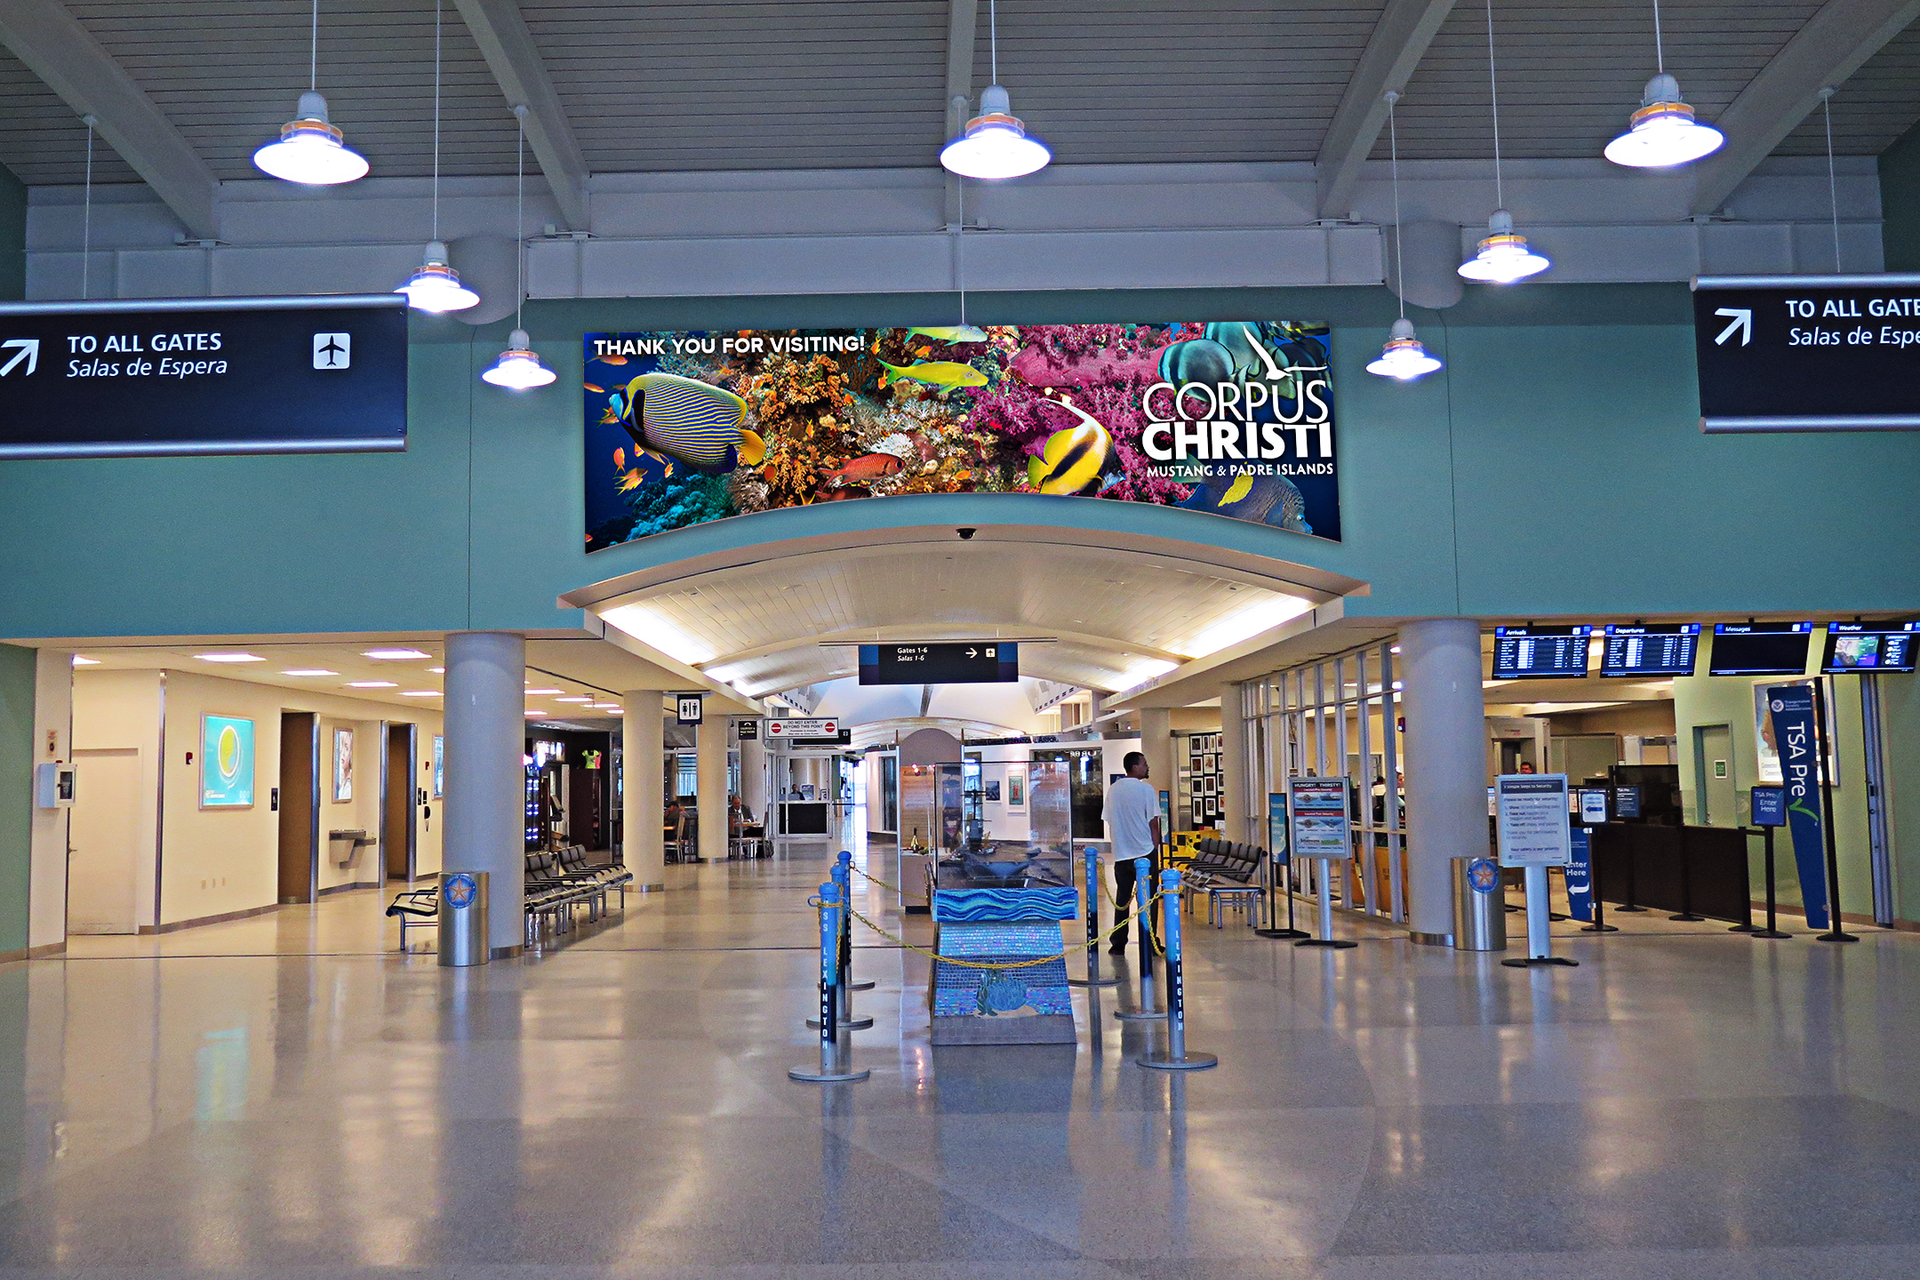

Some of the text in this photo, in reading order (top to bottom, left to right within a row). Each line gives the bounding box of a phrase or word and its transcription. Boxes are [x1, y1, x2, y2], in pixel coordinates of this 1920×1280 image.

[1785, 300, 1815, 318] TO
[1822, 300, 1862, 317] ALL
[67, 333, 222, 354] TO ALL GATES
[594, 336, 866, 356] THANK YOU FOR VISITING!
[1788, 327, 1840, 346] Salas
[1847, 326, 1873, 345] de
[66, 358, 228, 379] Salas de Espera
[1142, 380, 1329, 424] CORPUS
[1142, 421, 1332, 460] CHRISTI
[1147, 463, 1334, 476] MUSTANG & PADRE ISLANDS
[1786, 721, 1808, 797] TSA Pre
[1175, 930, 1184, 1031] LEXINGTON
